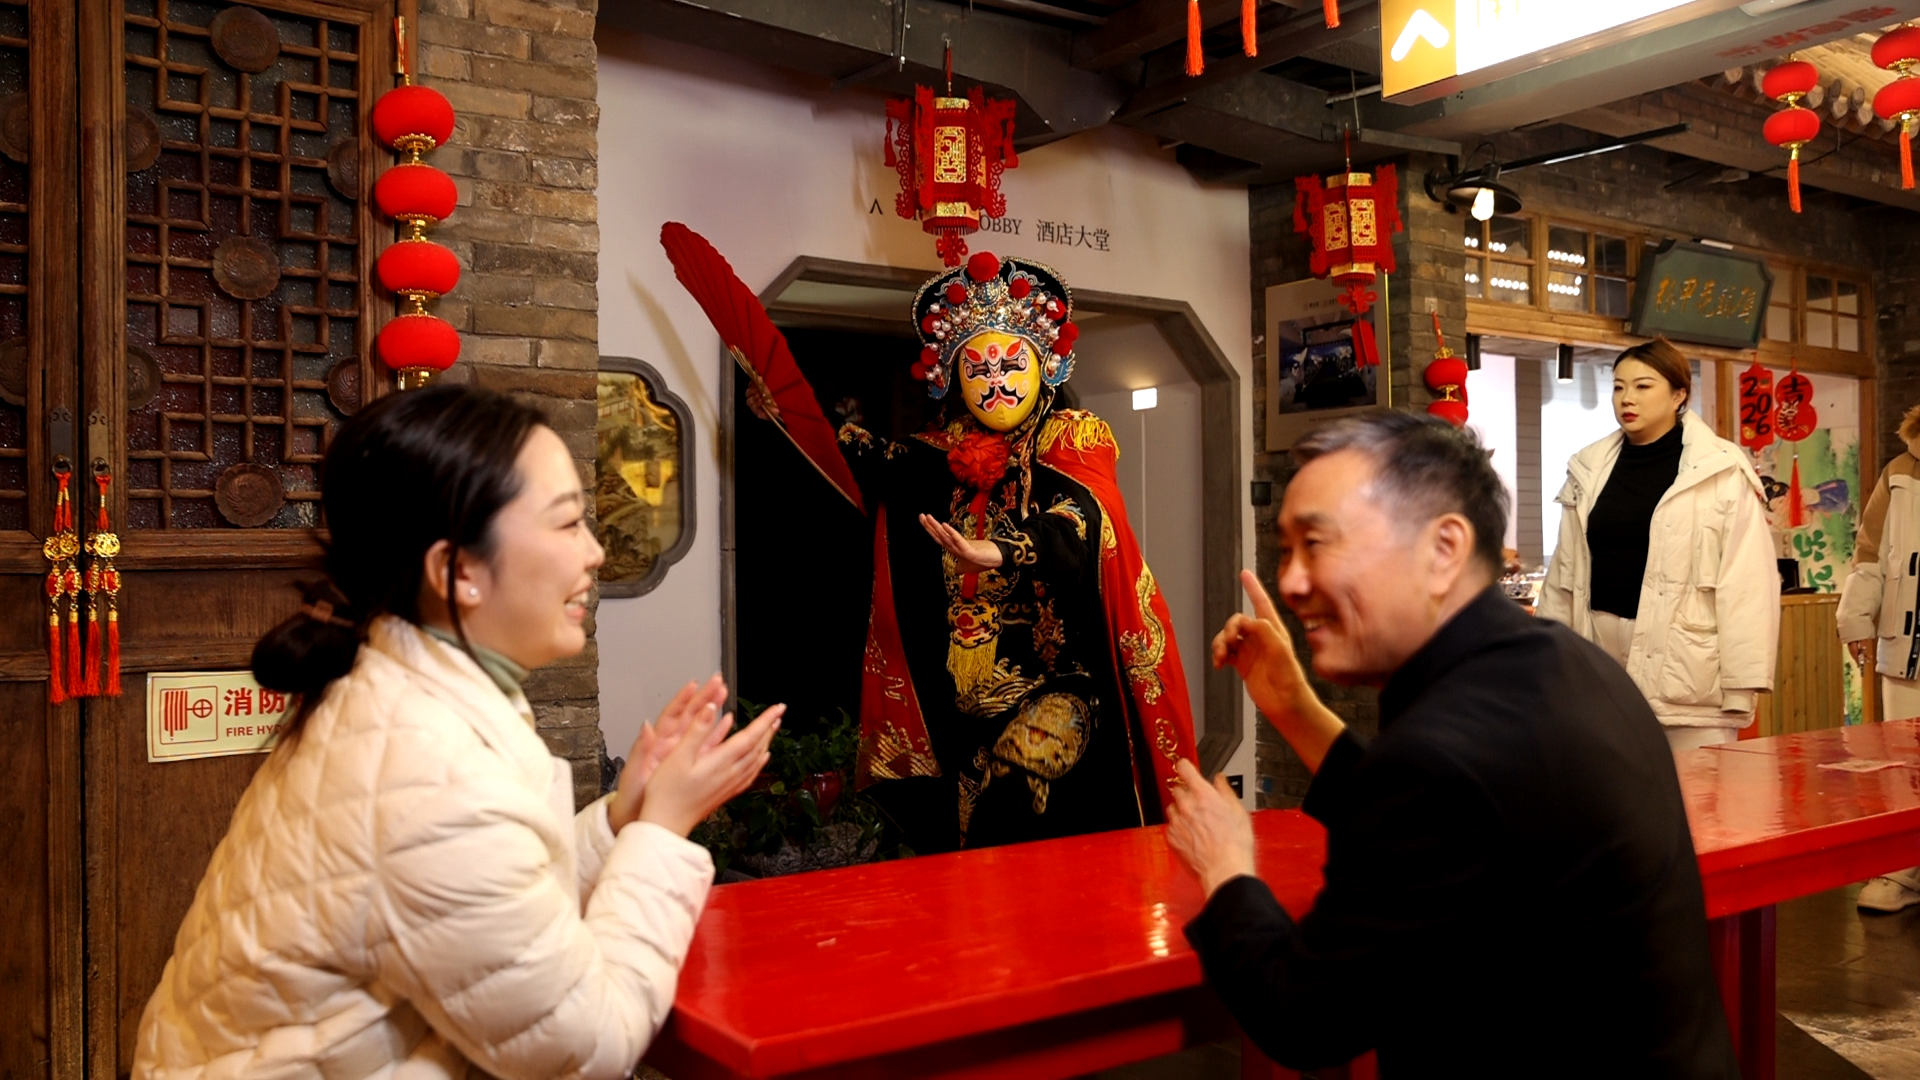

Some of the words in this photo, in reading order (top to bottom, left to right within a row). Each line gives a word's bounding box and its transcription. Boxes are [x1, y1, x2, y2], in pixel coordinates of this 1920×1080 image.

[979, 214, 1023, 236] OBBY
[1036, 219, 1110, 252] 酒店大堂
[223, 687, 303, 716] 消防
[226, 726, 254, 737] FIRE
